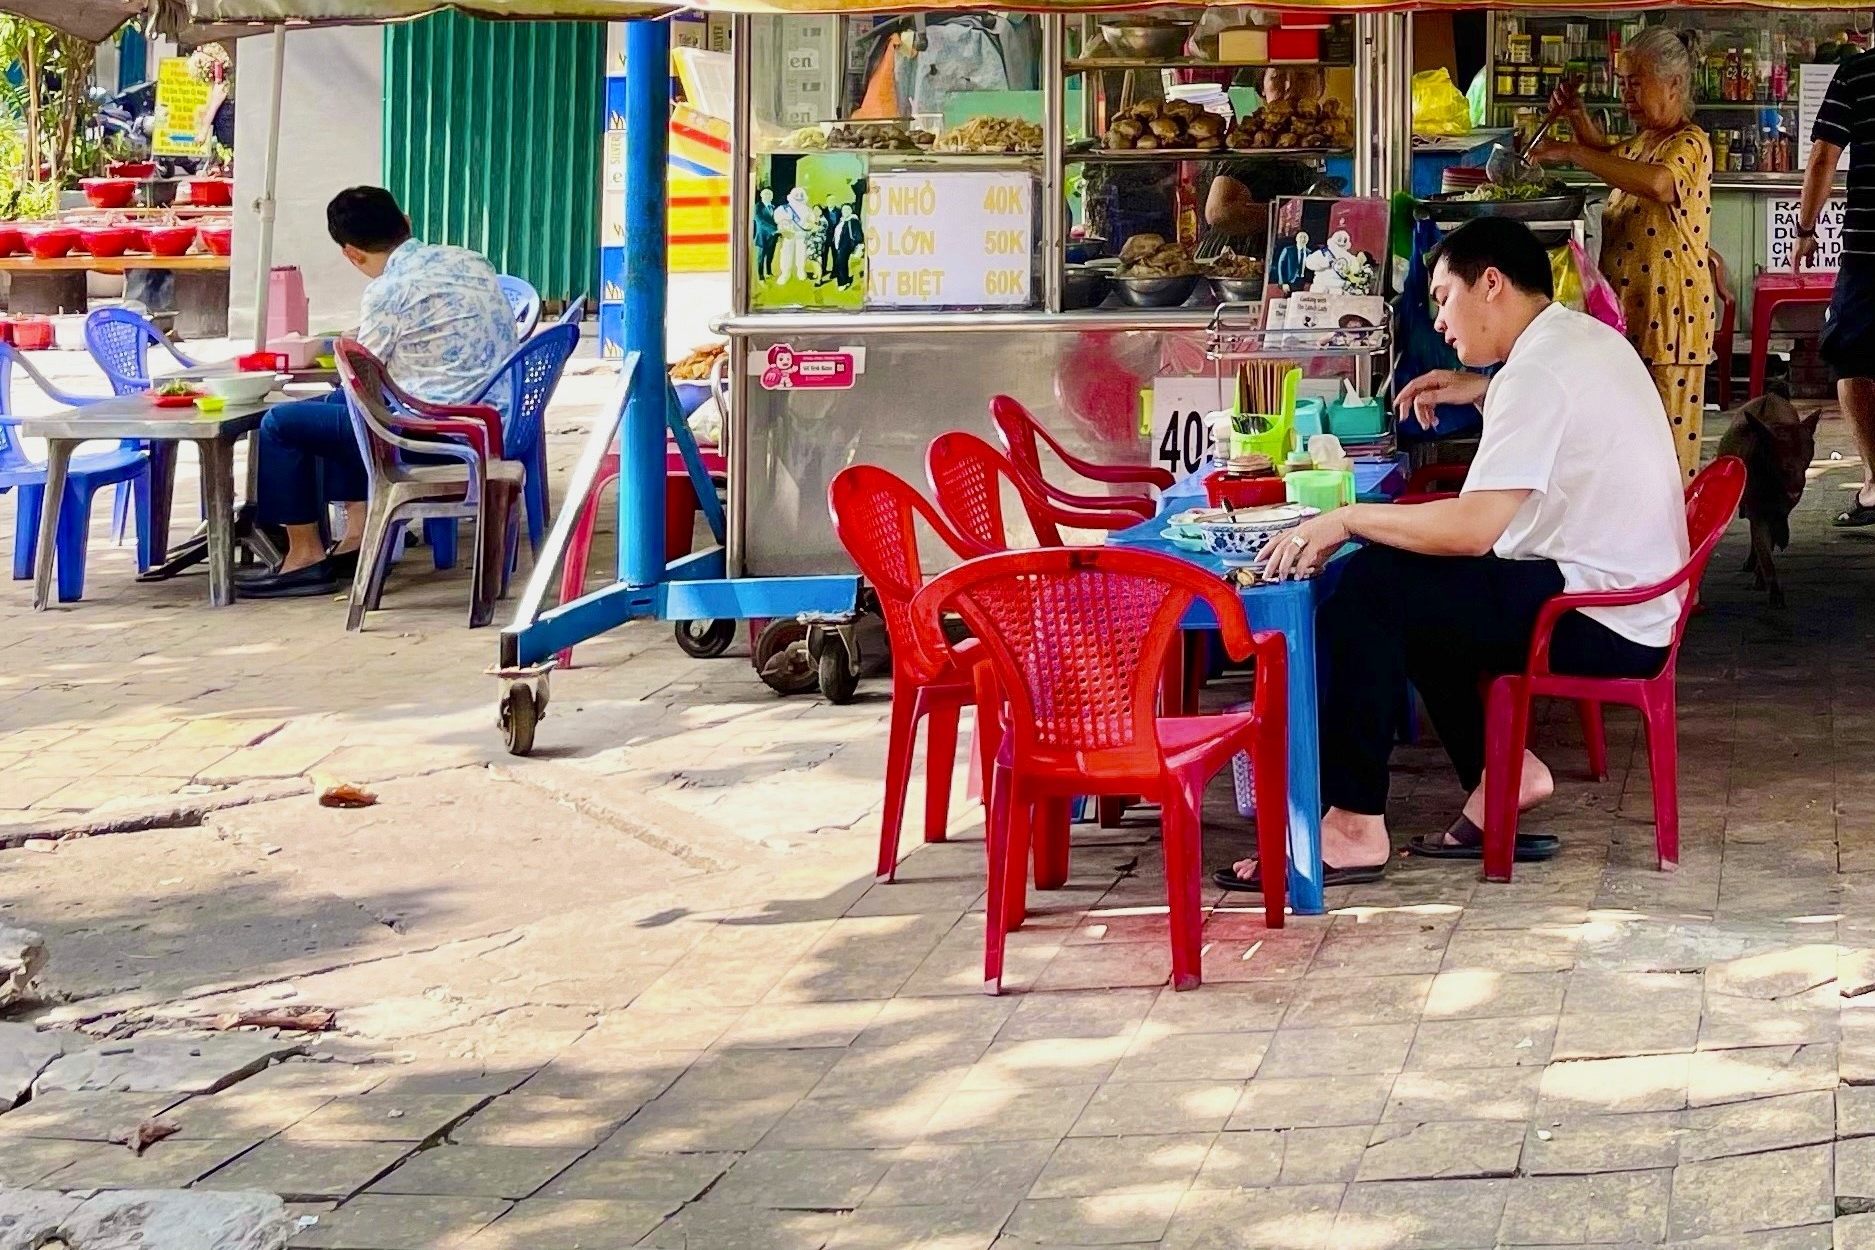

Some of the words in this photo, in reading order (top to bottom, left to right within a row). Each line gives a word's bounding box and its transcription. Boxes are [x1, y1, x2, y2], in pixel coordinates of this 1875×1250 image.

[887, 180, 936, 216] NHỎ
[983, 185, 1025, 215] 40K
[887, 225, 935, 255] LỚN
[984, 230, 1025, 255] 50K
[985, 270, 1025, 295] 60K
